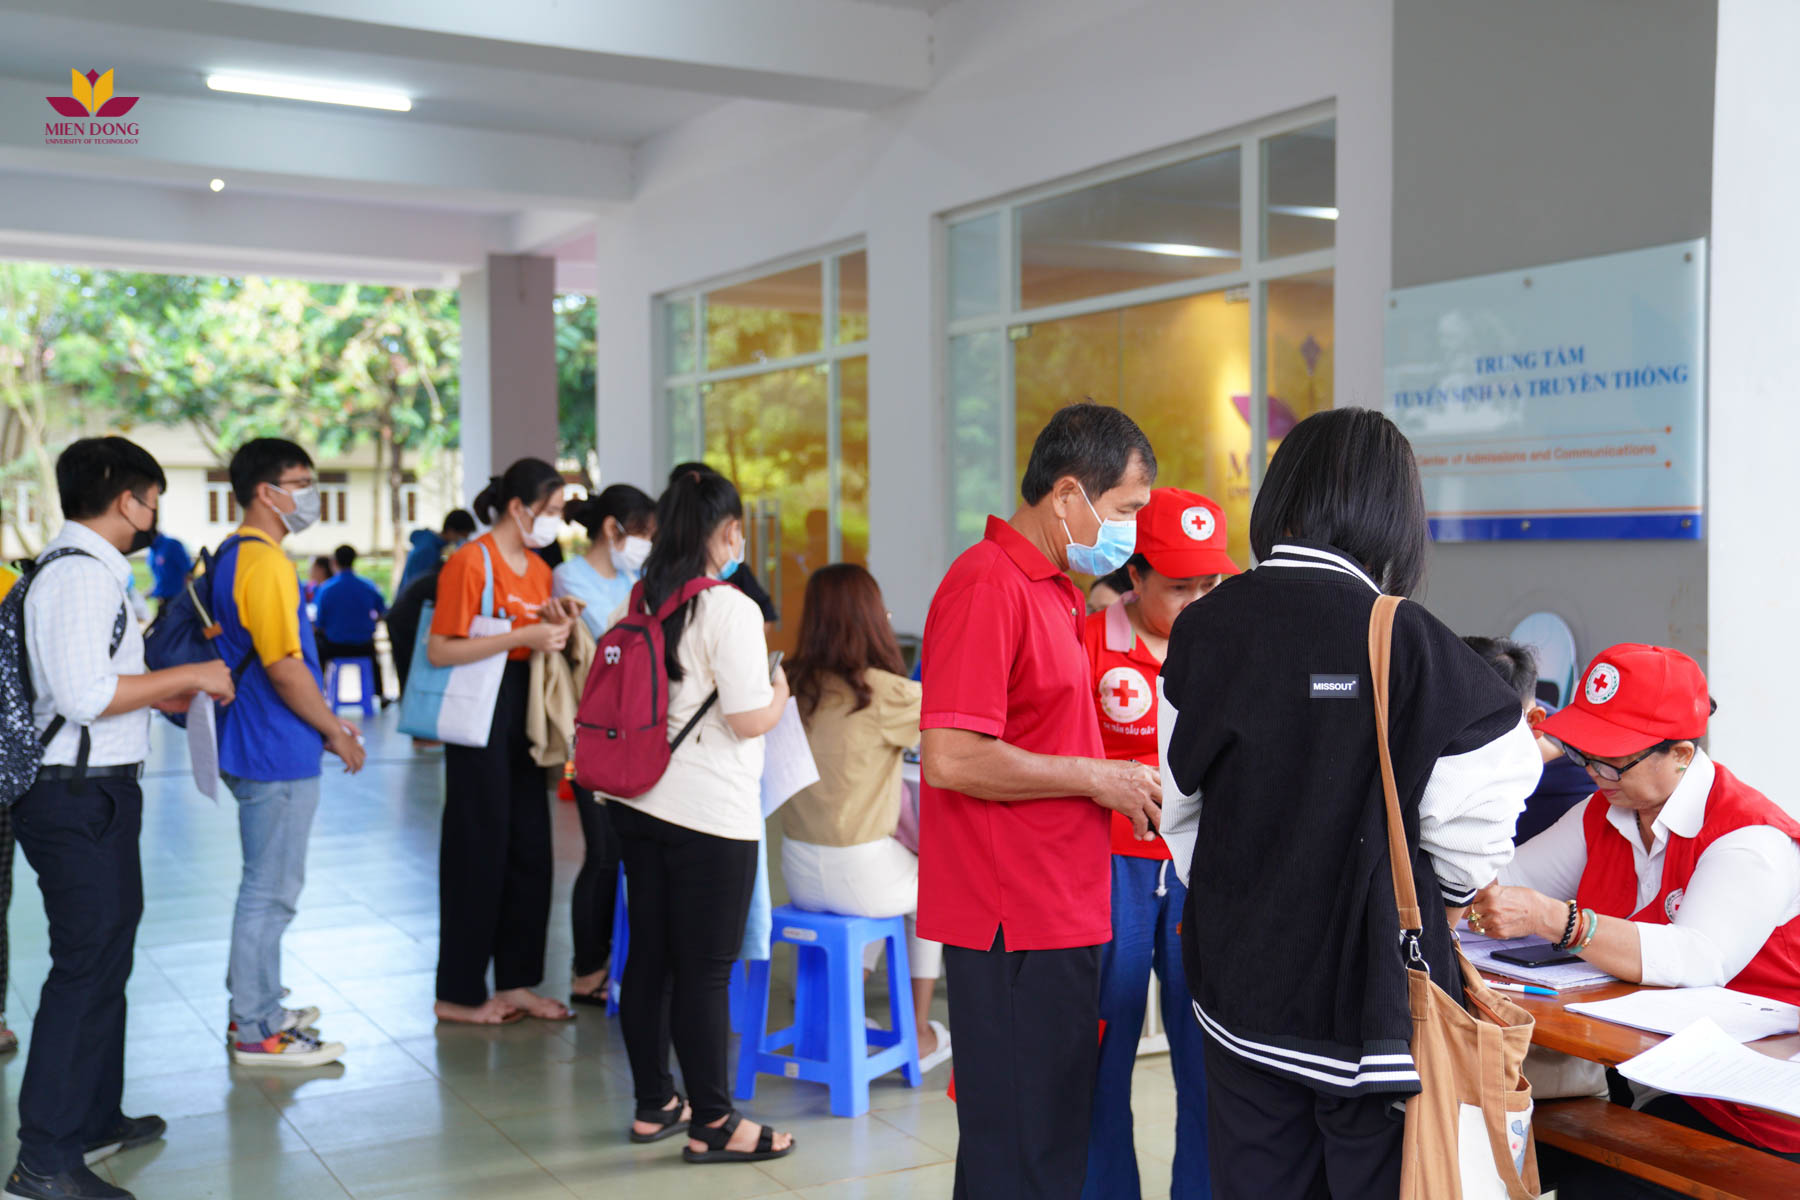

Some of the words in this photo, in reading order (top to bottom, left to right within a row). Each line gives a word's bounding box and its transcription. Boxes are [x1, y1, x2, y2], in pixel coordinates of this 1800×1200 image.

[1475, 352, 1537, 376] TRUNG
[1544, 344, 1585, 368] TÂM
[1450, 384, 1493, 405] SINH
[1611, 361, 1689, 391] THÔNG
[1452, 453, 1463, 464] of
[1465, 450, 1527, 464] Admissions
[1530, 448, 1551, 462] and
[1553, 443, 1657, 460] Communications
